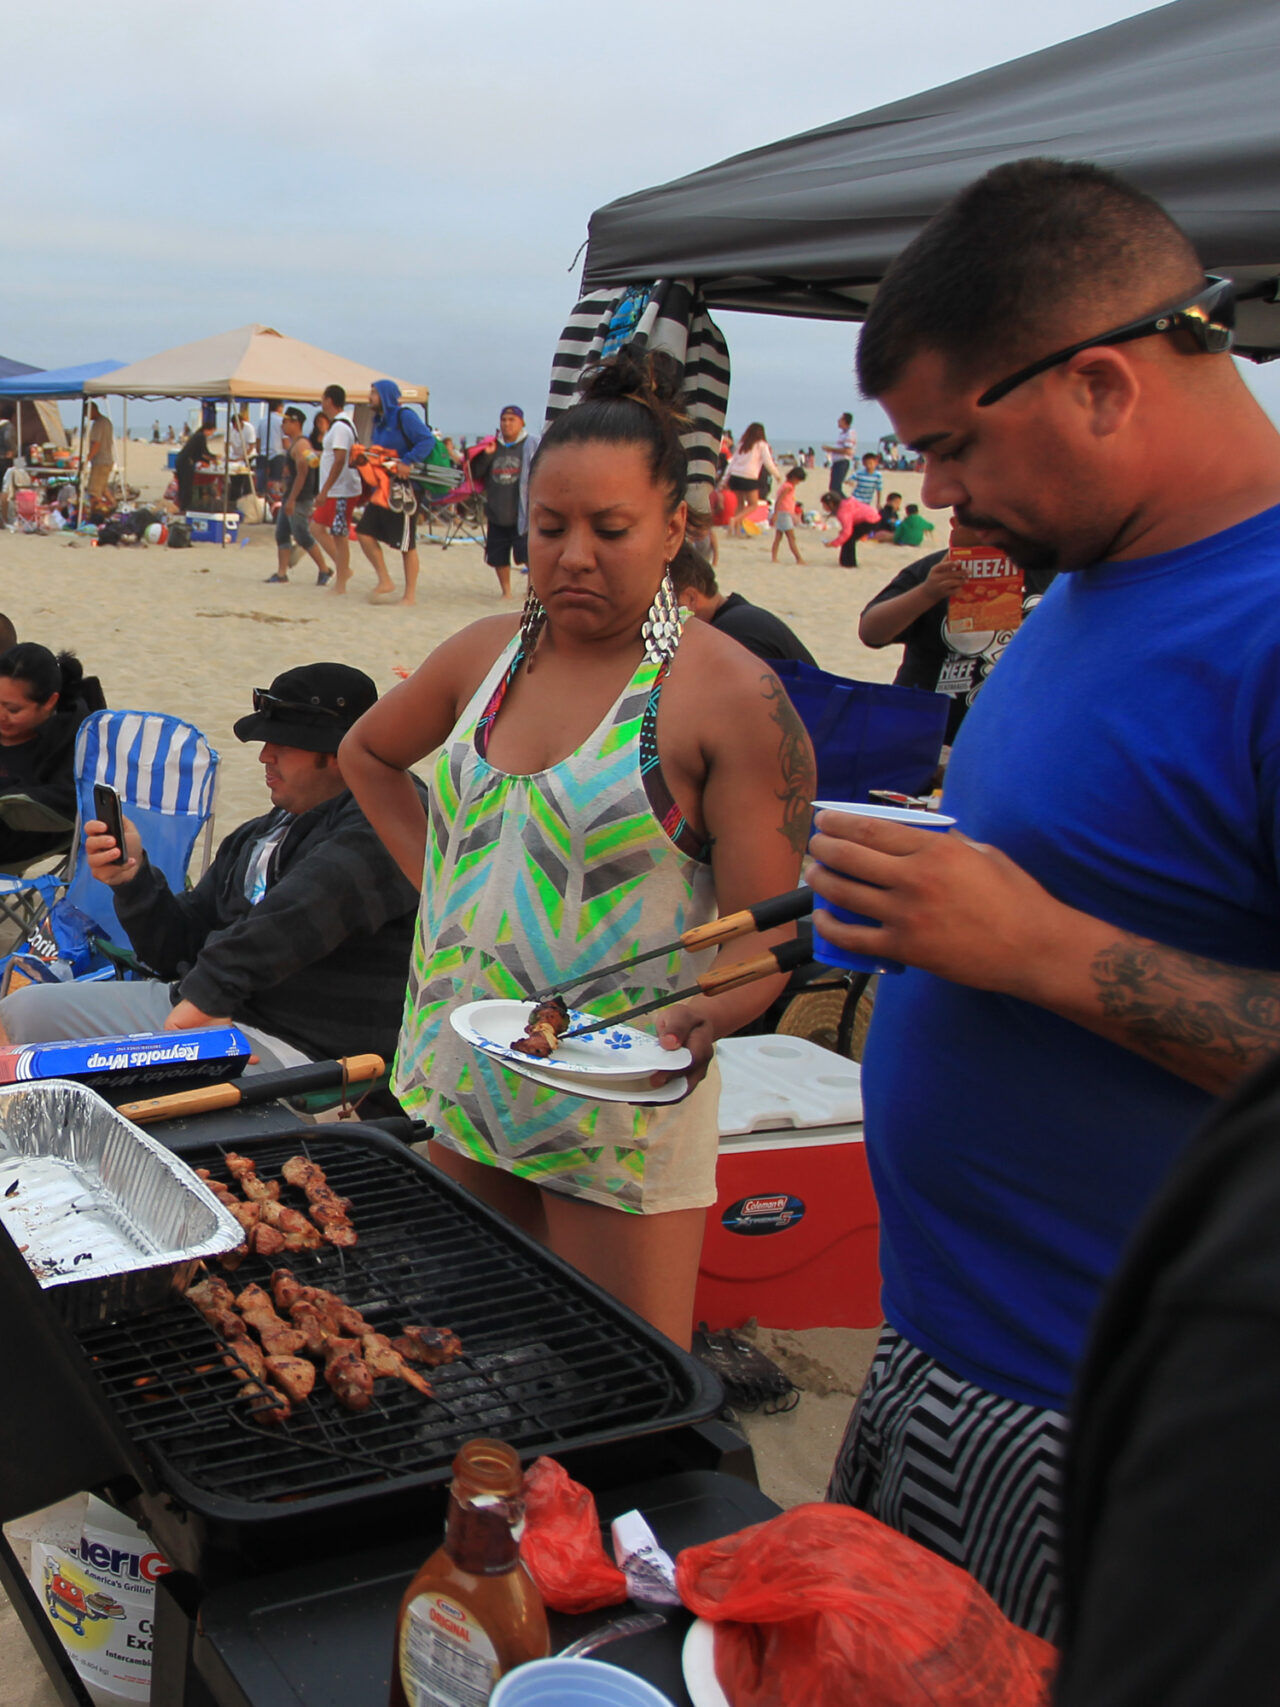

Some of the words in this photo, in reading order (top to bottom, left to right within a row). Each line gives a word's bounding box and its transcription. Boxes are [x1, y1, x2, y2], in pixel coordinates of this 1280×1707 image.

[939, 659, 977, 681] NEFF
[87, 1053, 128, 1070] Wrap
[131, 1044, 199, 1063] Reynolds
[88, 1074, 138, 1087] Wrap
[140, 1064, 233, 1083] Reynolds
[746, 1200, 777, 1211] Coleman
[85, 1569, 122, 1589] America's
[429, 1607, 471, 1643] ORIGINAL
